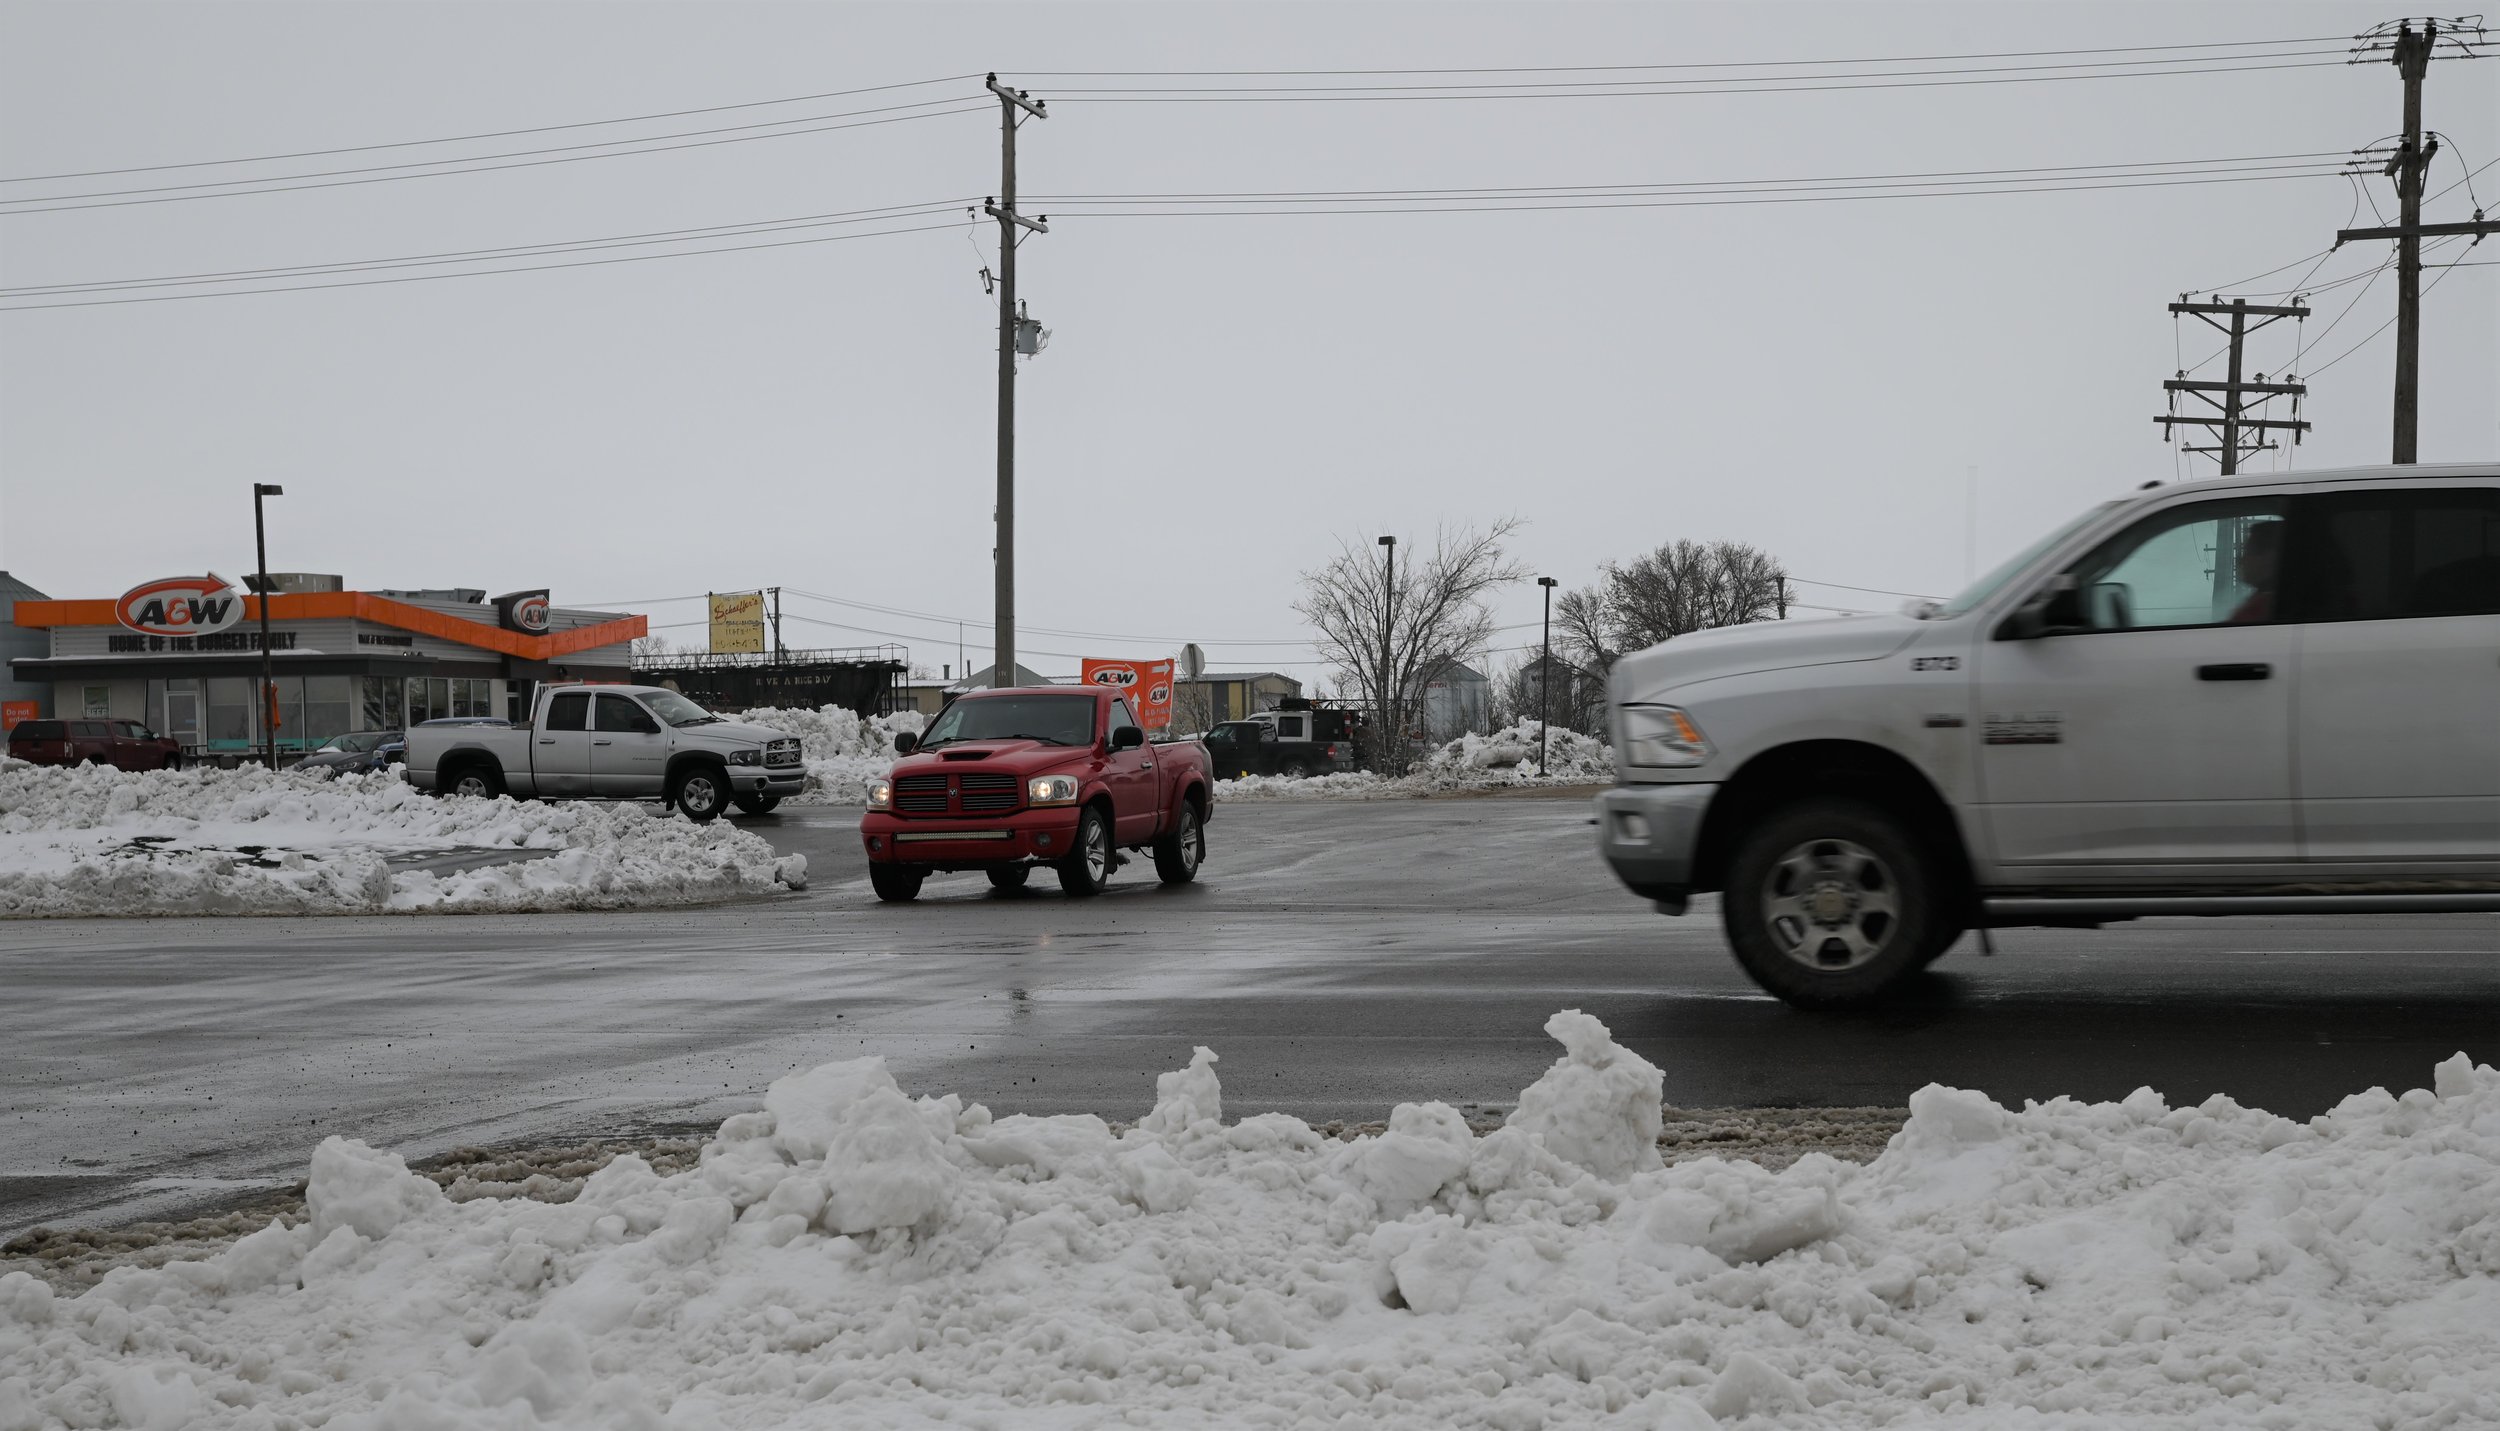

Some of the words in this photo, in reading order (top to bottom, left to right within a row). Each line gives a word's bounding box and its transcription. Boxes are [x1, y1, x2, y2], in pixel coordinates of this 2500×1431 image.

[134, 597, 233, 626] A&W
[524, 607, 548, 624] A&W
[108, 635, 147, 652] HOME
[149, 636, 165, 652] OF
[170, 636, 194, 651] THE
[196, 633, 248, 652] BURGER
[756, 677, 778, 686] HVE
[794, 676, 812, 685] NICE
[815, 674, 831, 684] DAY
[1096, 672, 1135, 684] A&W
[1151, 689, 1168, 701] A&W
[6, 708, 17, 716] Do
[17, 708, 29, 716] not
[86, 708, 107, 718] BEEF
